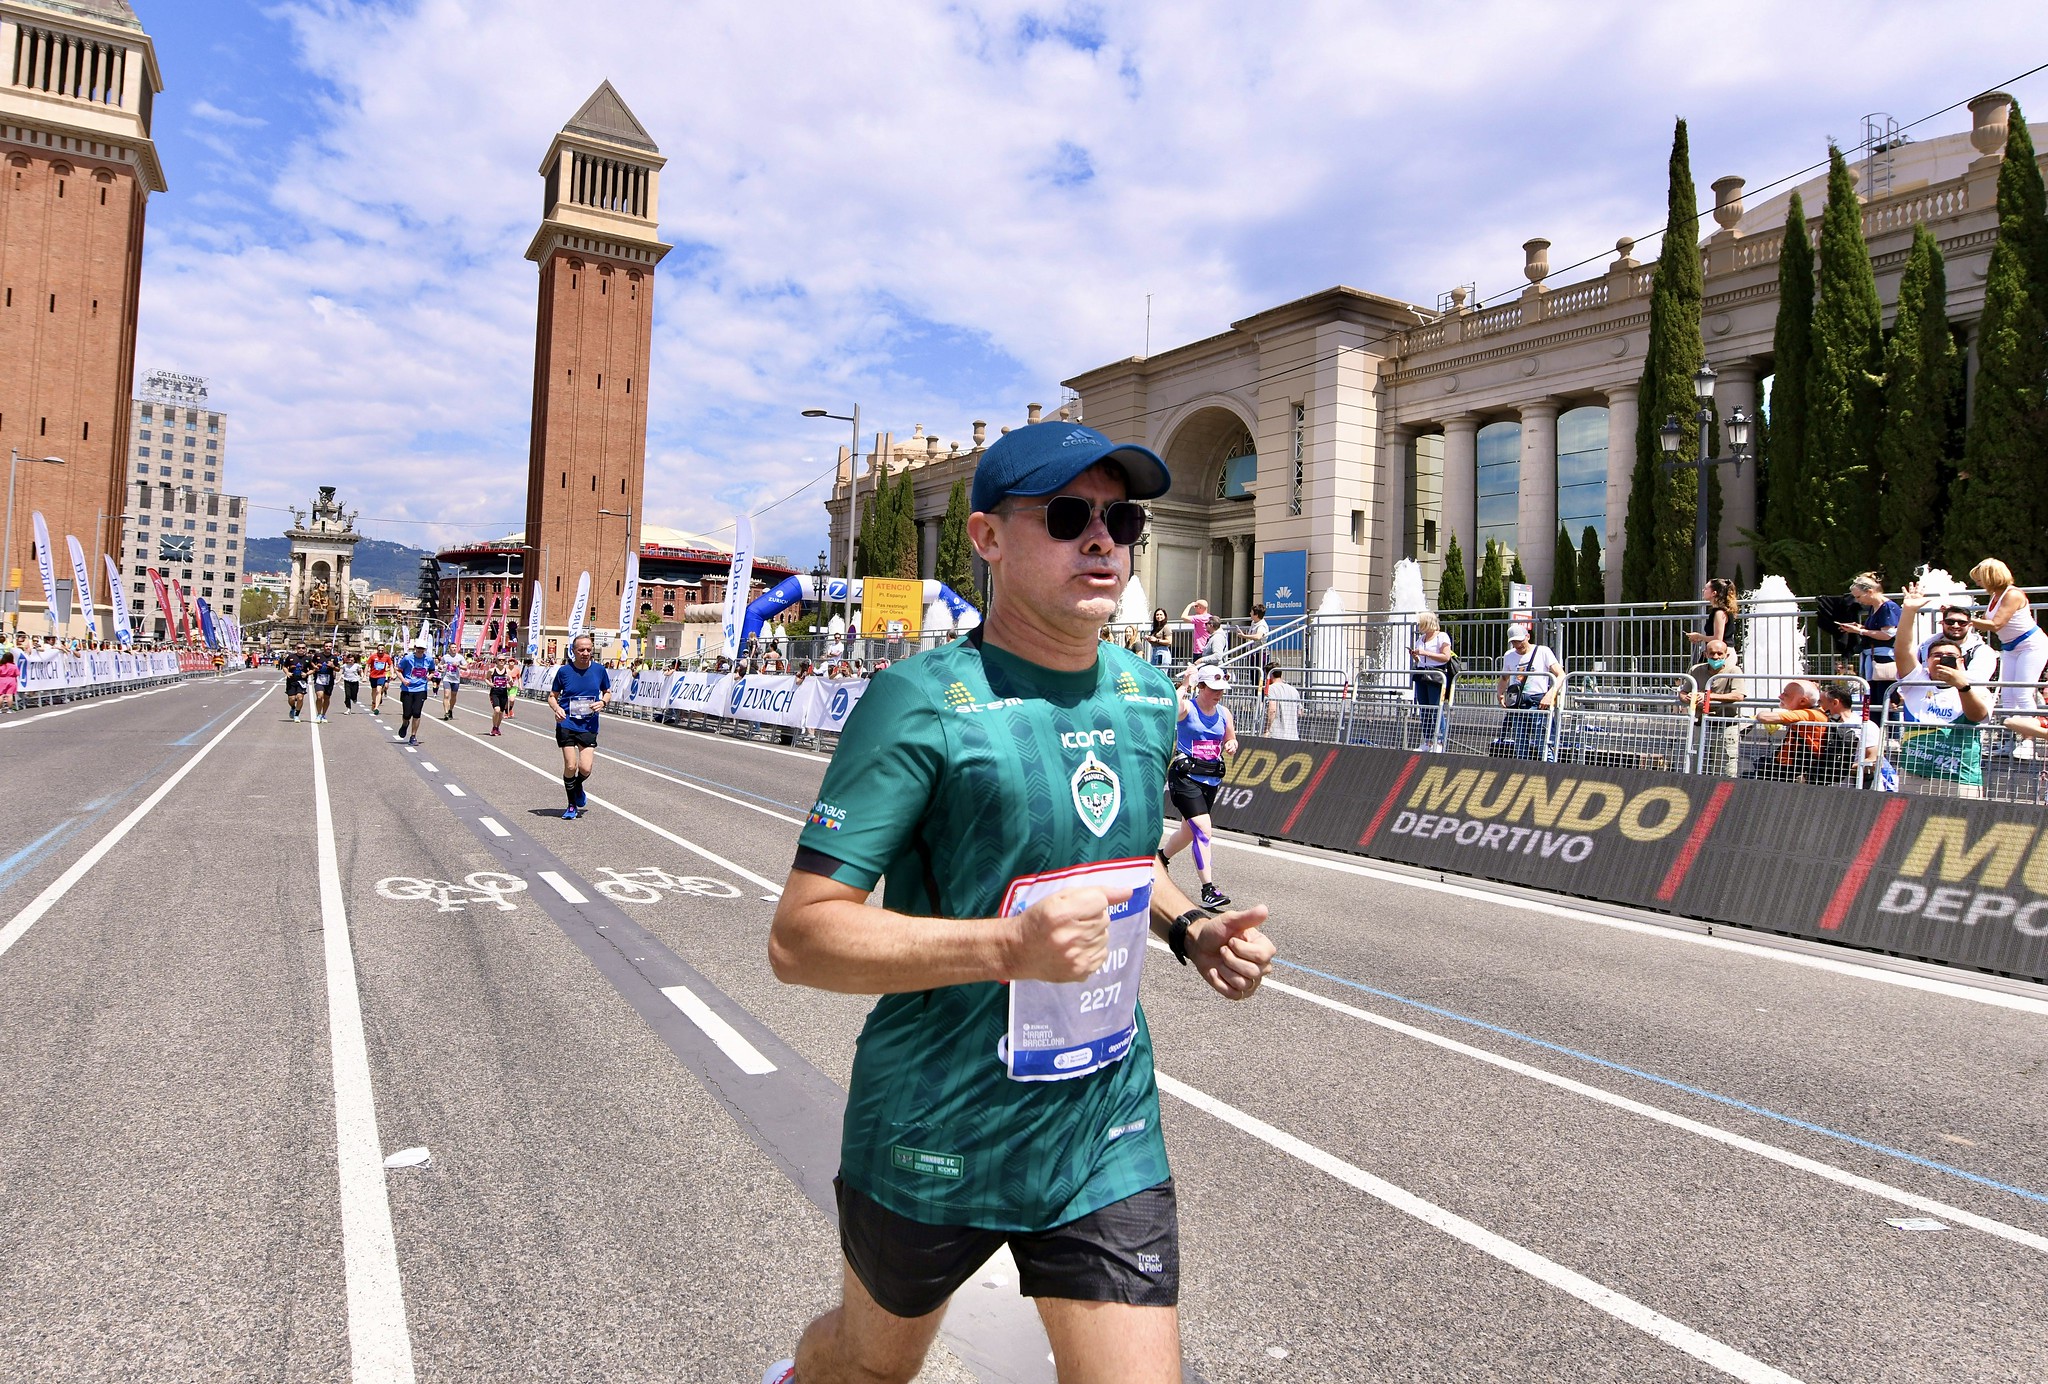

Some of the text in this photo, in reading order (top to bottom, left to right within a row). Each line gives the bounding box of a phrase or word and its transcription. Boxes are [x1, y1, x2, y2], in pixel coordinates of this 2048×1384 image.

[157, 371, 203, 383] CATALONIA
[151, 380, 208, 396] PLAZA
[875, 582, 912, 592] ATENCIÓ
[767, 596, 789, 605] ZURICH
[1276, 601, 1303, 609] Barcelona
[30, 661, 59, 681] ZURICH
[638, 680, 661, 699] ZURICH
[678, 683, 715, 703] ZURICH
[743, 687, 795, 713] ZURICH
[1221, 747, 1313, 793] NDO
[1406, 765, 1691, 842] MUNDO
[1391, 811, 1595, 863] DEPORTIVO
[1095, 947, 1128, 975] VID
[1079, 981, 1122, 1014] 2277
[1022, 1028, 1054, 1039] MARATÓ
[1022, 1037, 1066, 1048] BARCELONA
[946, 1157, 955, 1167] FC
[1136, 1251, 1161, 1263] Track
[1145, 1262, 1163, 1273] Field
